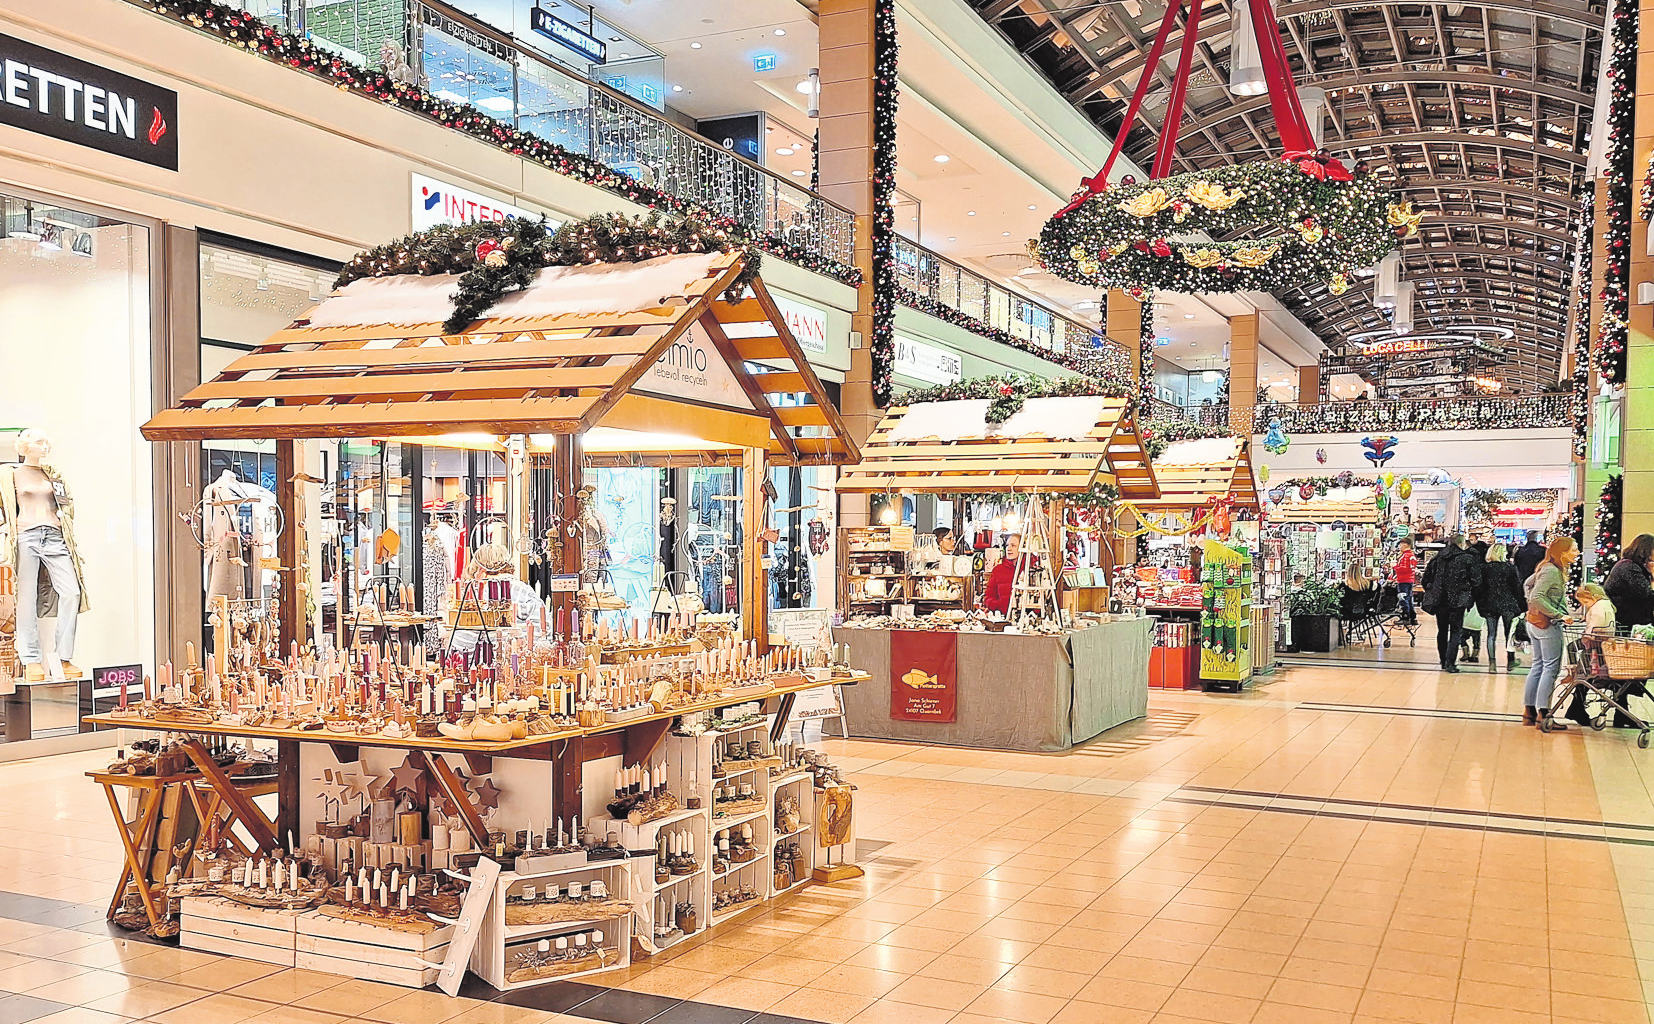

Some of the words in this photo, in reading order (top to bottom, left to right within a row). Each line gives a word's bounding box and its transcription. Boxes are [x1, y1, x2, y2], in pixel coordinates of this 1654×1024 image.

[0, 58, 137, 140] ETTEN
[1417, 407, 1492, 421] PASTA
[98, 669, 135, 684] JOBS
